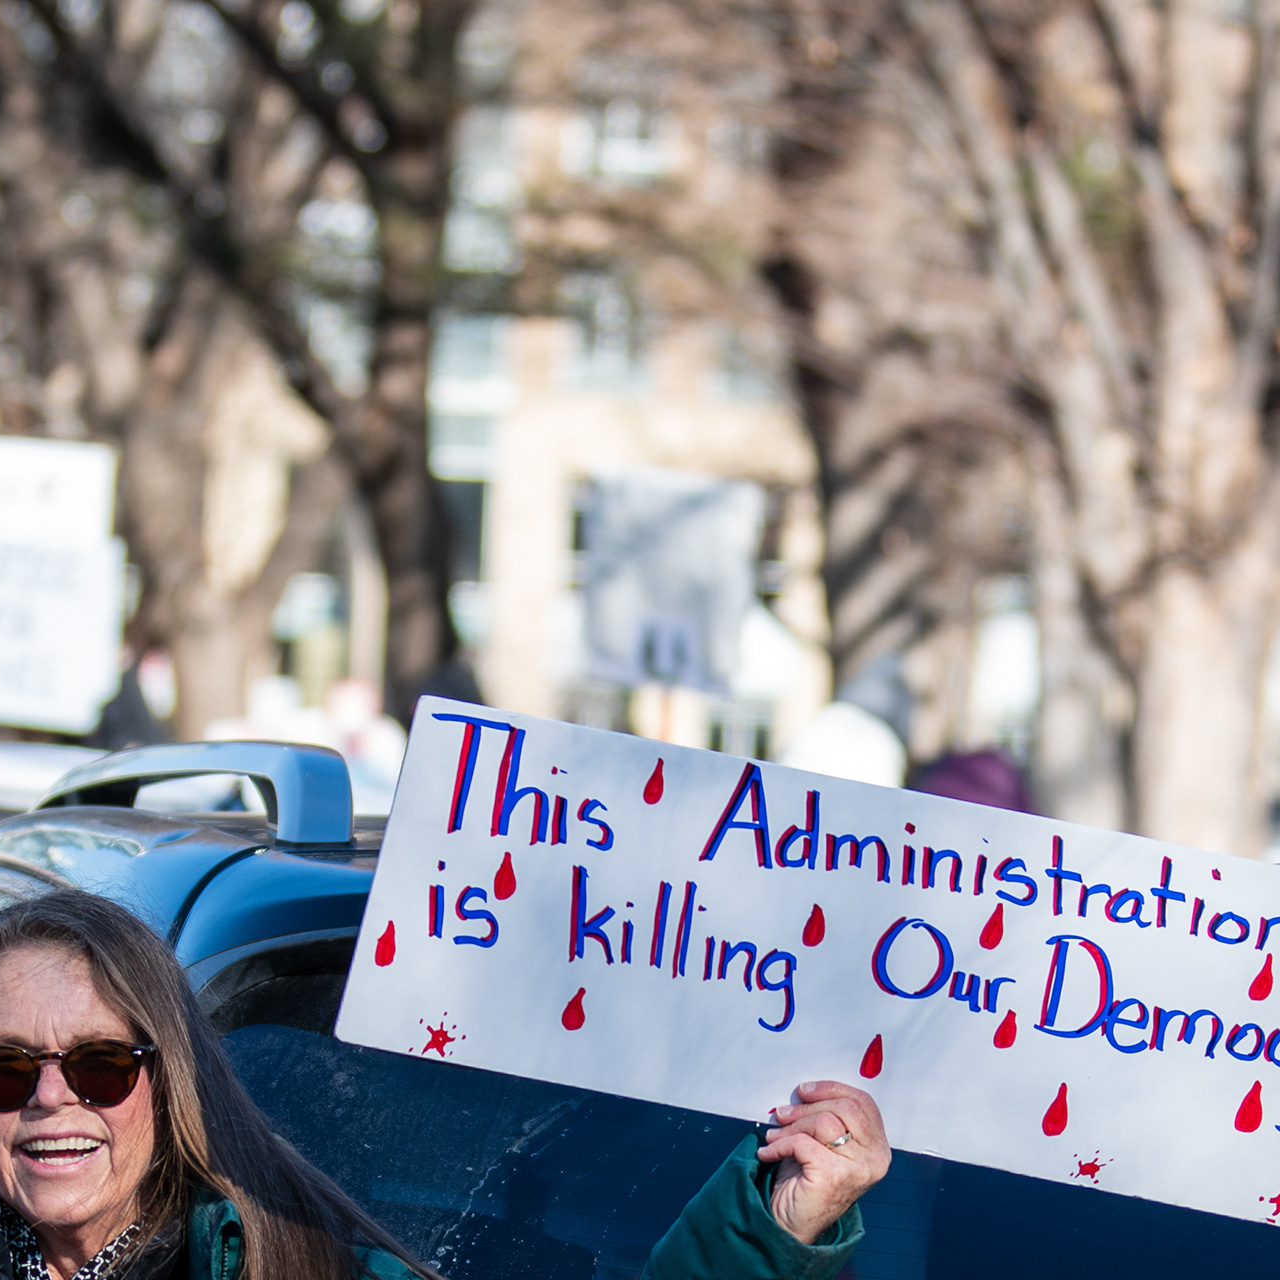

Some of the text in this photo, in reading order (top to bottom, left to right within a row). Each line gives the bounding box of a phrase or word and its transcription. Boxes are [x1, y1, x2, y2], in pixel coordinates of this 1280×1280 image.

[432, 714, 615, 851] This
[429, 860, 498, 948] is
[569, 866, 797, 1032] killing
[872, 917, 1016, 1014] Our
